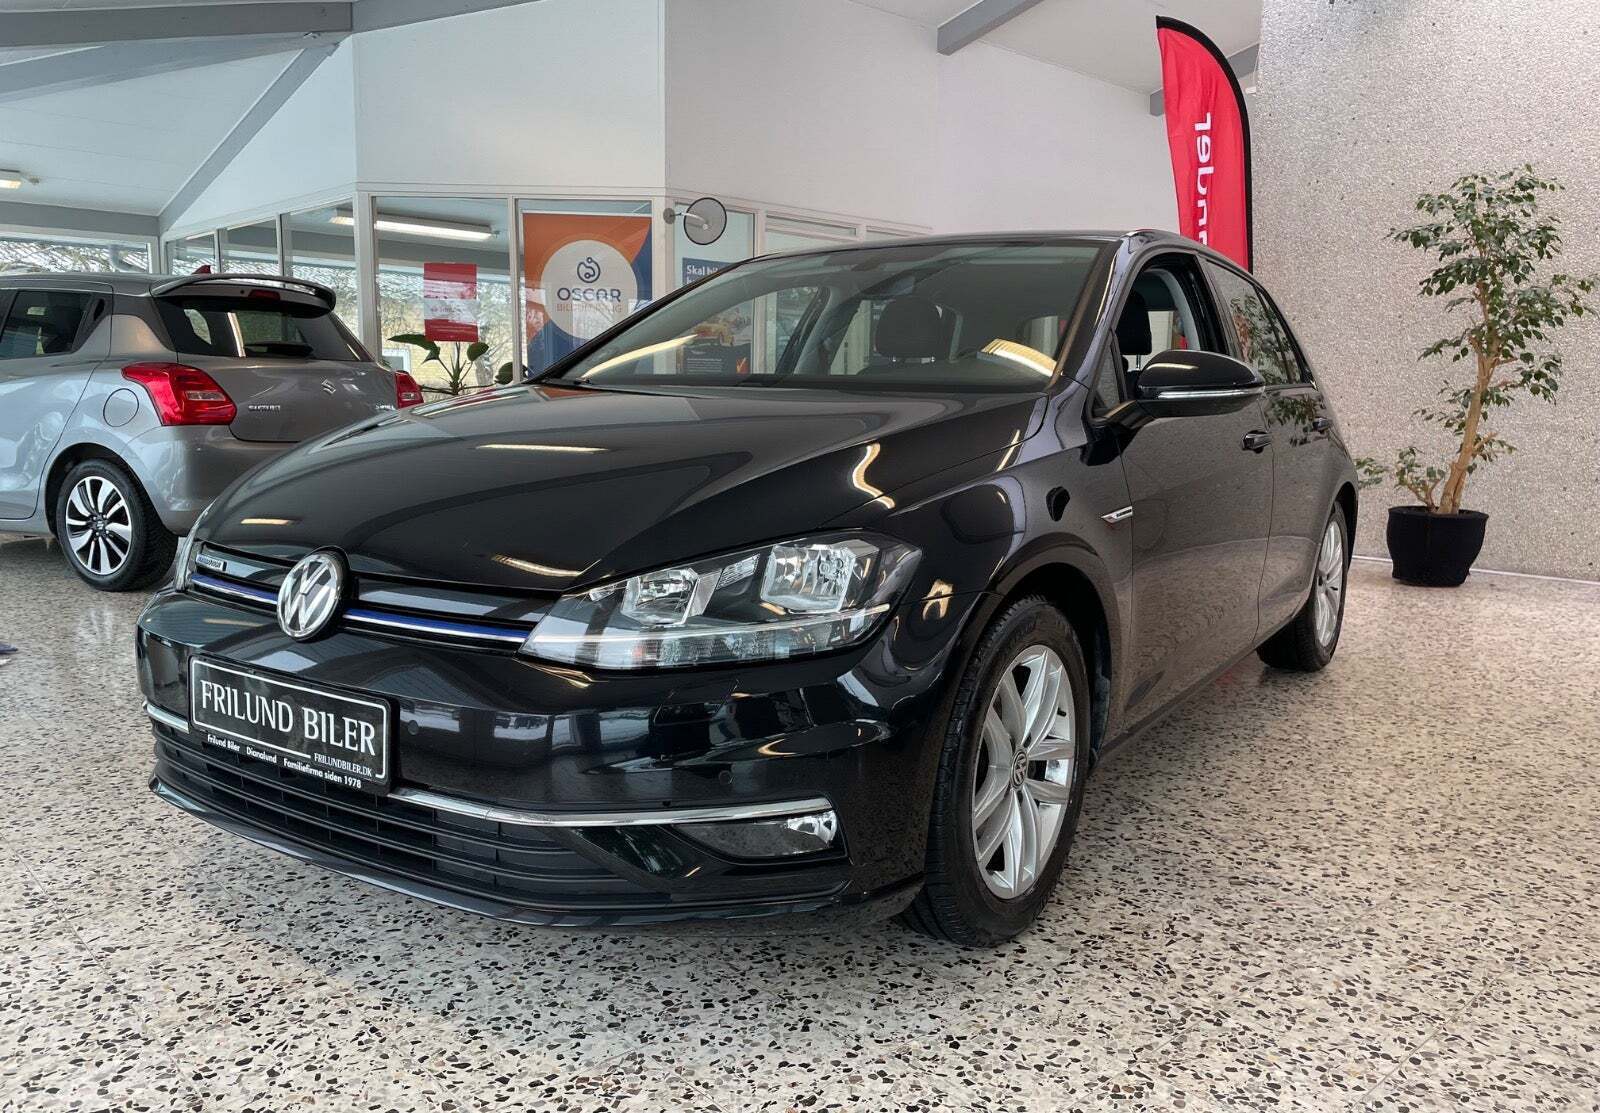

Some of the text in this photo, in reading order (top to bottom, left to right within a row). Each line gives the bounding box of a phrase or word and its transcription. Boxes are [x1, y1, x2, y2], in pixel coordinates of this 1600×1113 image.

[687, 265, 705, 276] Skal
[556, 287, 622, 303] OSCAR
[200, 680, 375, 756] FRILUND BILER
[207, 734, 361, 789] Frilund Biler Dianalund Familiefirma siden 1978
[314, 753, 372, 777] FRILUNDBILER.DK
